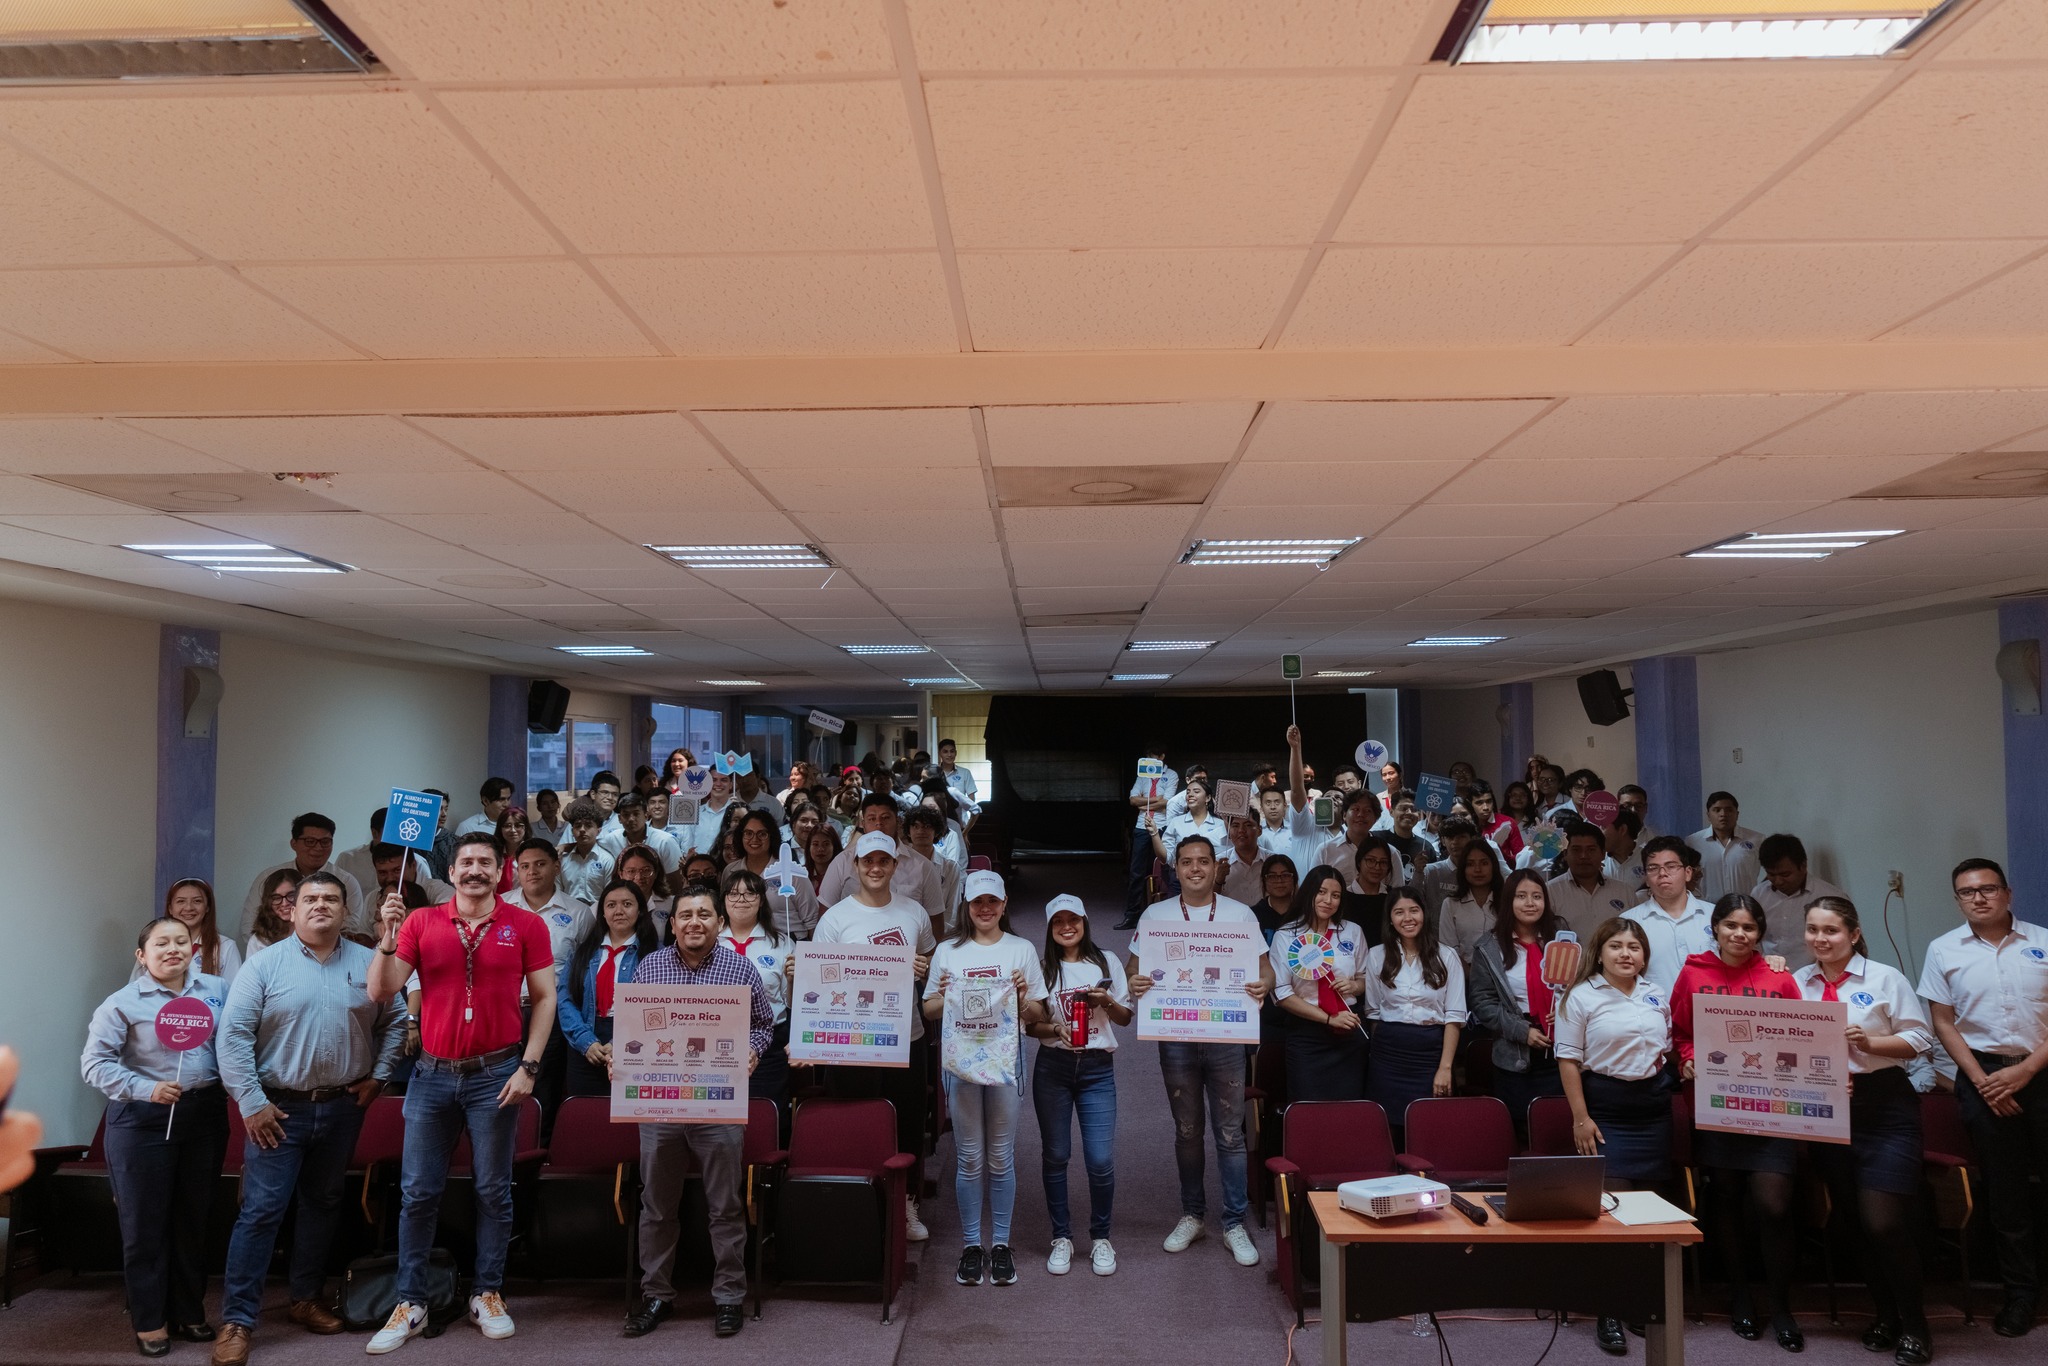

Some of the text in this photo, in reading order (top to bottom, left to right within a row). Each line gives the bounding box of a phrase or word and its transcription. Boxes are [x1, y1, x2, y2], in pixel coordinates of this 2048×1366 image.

[811, 712, 842, 728] Poza Rica
[1422, 776, 1429, 784] 17
[393, 792, 402, 804] 17
[404, 794, 422, 802] ALIANZAS
[410, 808, 430, 818] OBJETIVOS
[870, 968, 888, 976] Rica
[1166, 998, 1213, 1006] OBJETIVOS
[670, 1012, 721, 1020] Poza Rica
[1705, 1008, 1836, 1022] MOVILIDAD INTERNACIONAL
[160, 1018, 185, 1026] POZA
[818, 1020, 865, 1030] OBJETIVOS
[1756, 1026, 1814, 1037] Poza Rica
[643, 1073, 696, 1082] OBJETIVOS
[1729, 1084, 1789, 1097] OBJETIVOS
